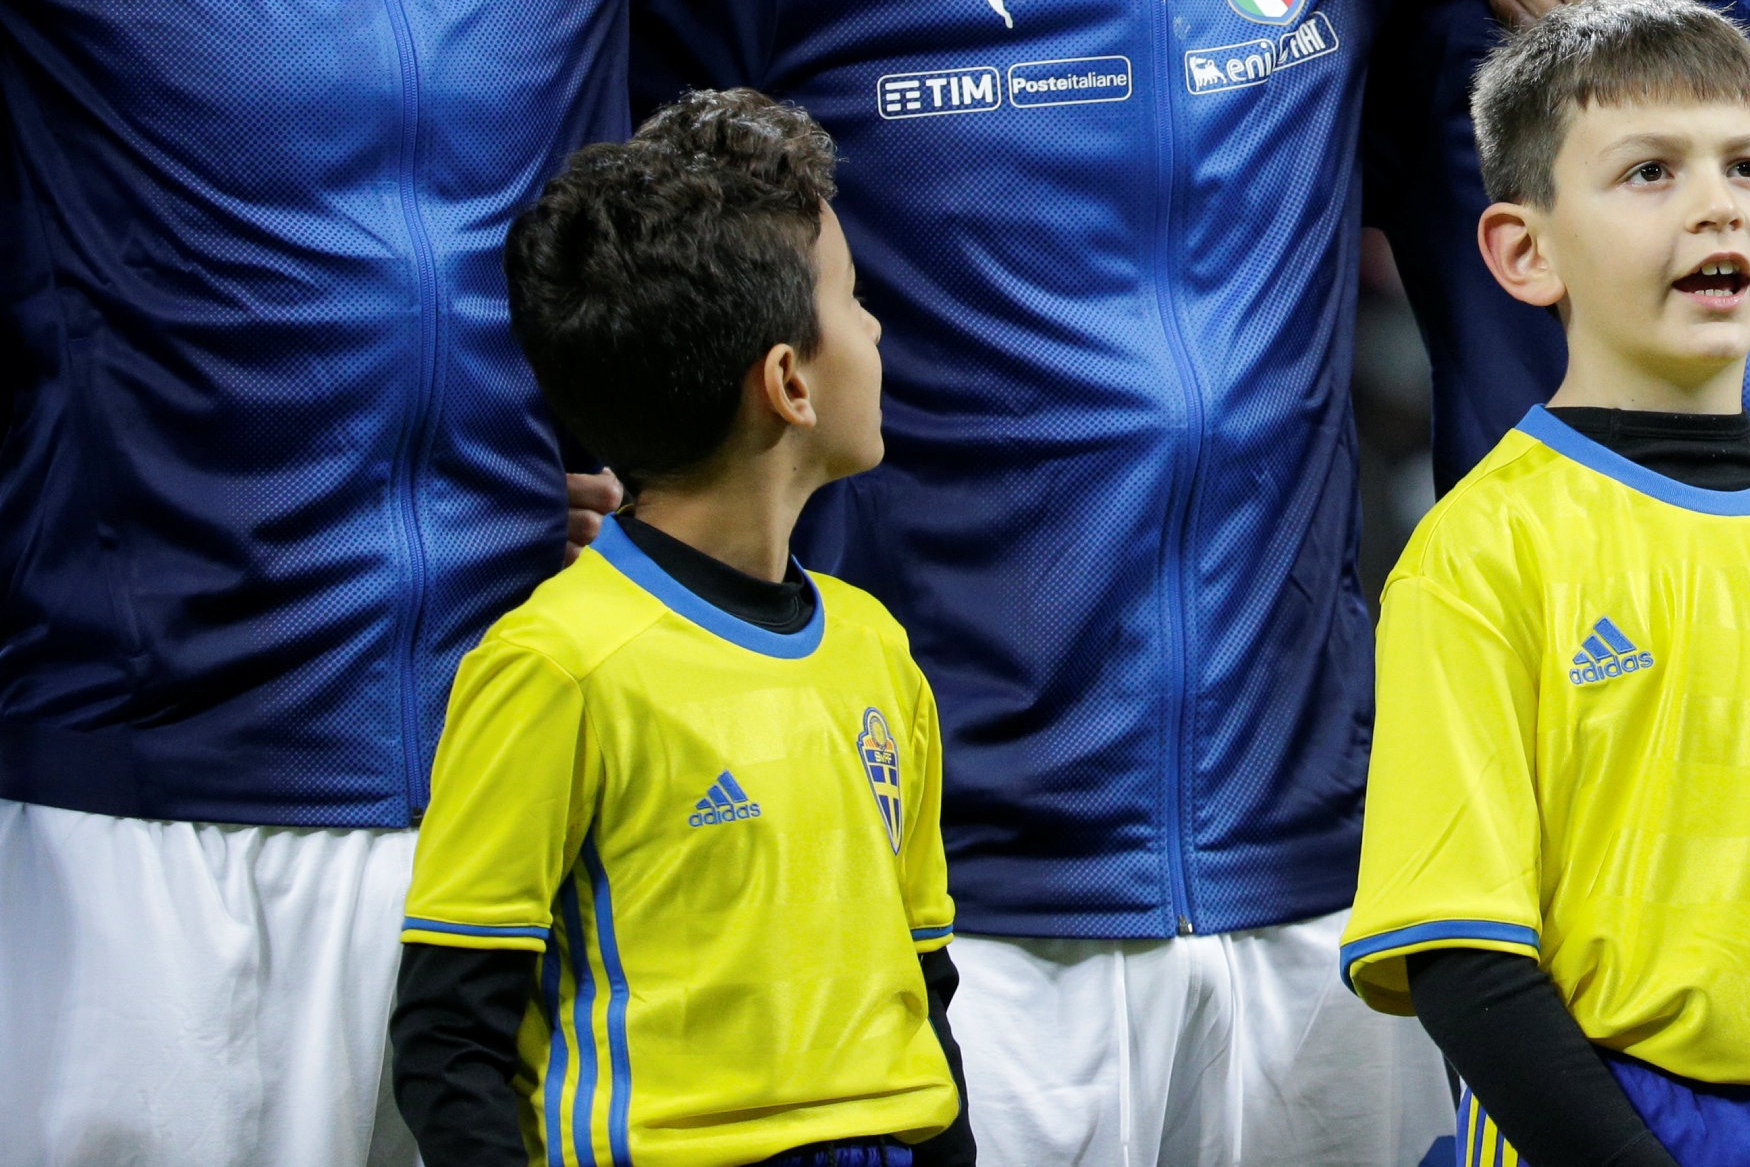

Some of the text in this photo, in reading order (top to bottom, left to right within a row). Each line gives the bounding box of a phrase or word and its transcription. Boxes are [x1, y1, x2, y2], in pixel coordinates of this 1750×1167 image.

[1226, 41, 1272, 83] eni
[926, 74, 993, 107] TIM
[1012, 72, 1127, 94] Posteitaliane
[1569, 649, 1654, 685] adidas
[688, 801, 761, 827] adidas
